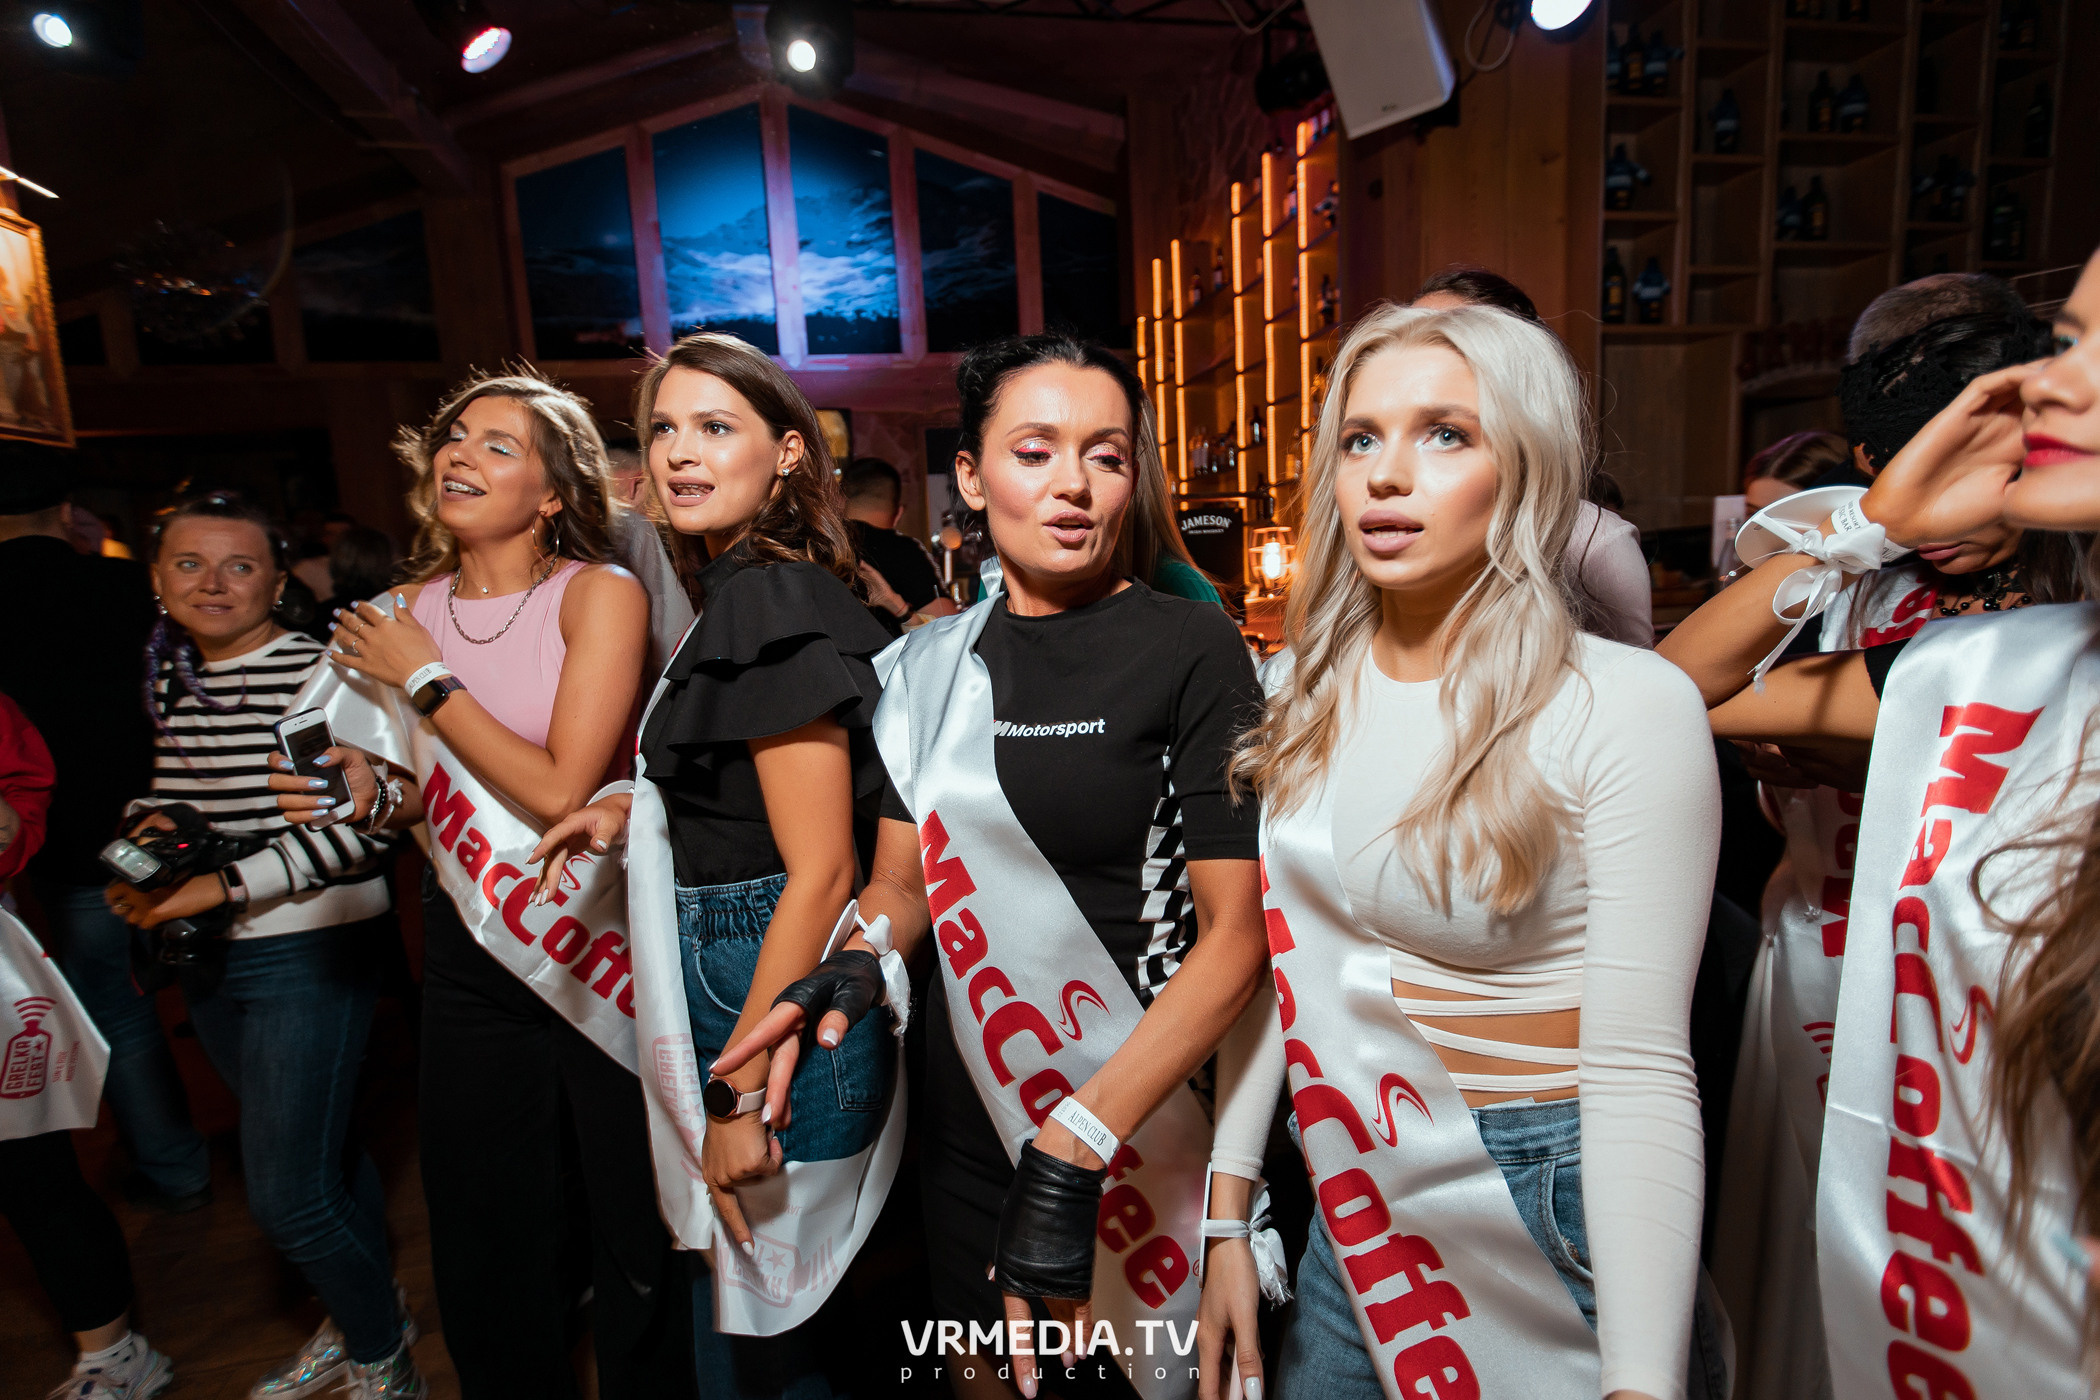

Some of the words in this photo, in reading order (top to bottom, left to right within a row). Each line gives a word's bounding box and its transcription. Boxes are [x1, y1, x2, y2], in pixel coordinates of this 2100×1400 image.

[1181, 514, 1231, 531] JAMESON
[1841, 516, 1853, 532] BAR
[1006, 718, 1106, 738] Motorsport
[6, 1040, 31, 1090] GRELKA
[1068, 1110, 1092, 1133] ALPEN
[1086, 1125, 1107, 1146] CLUB
